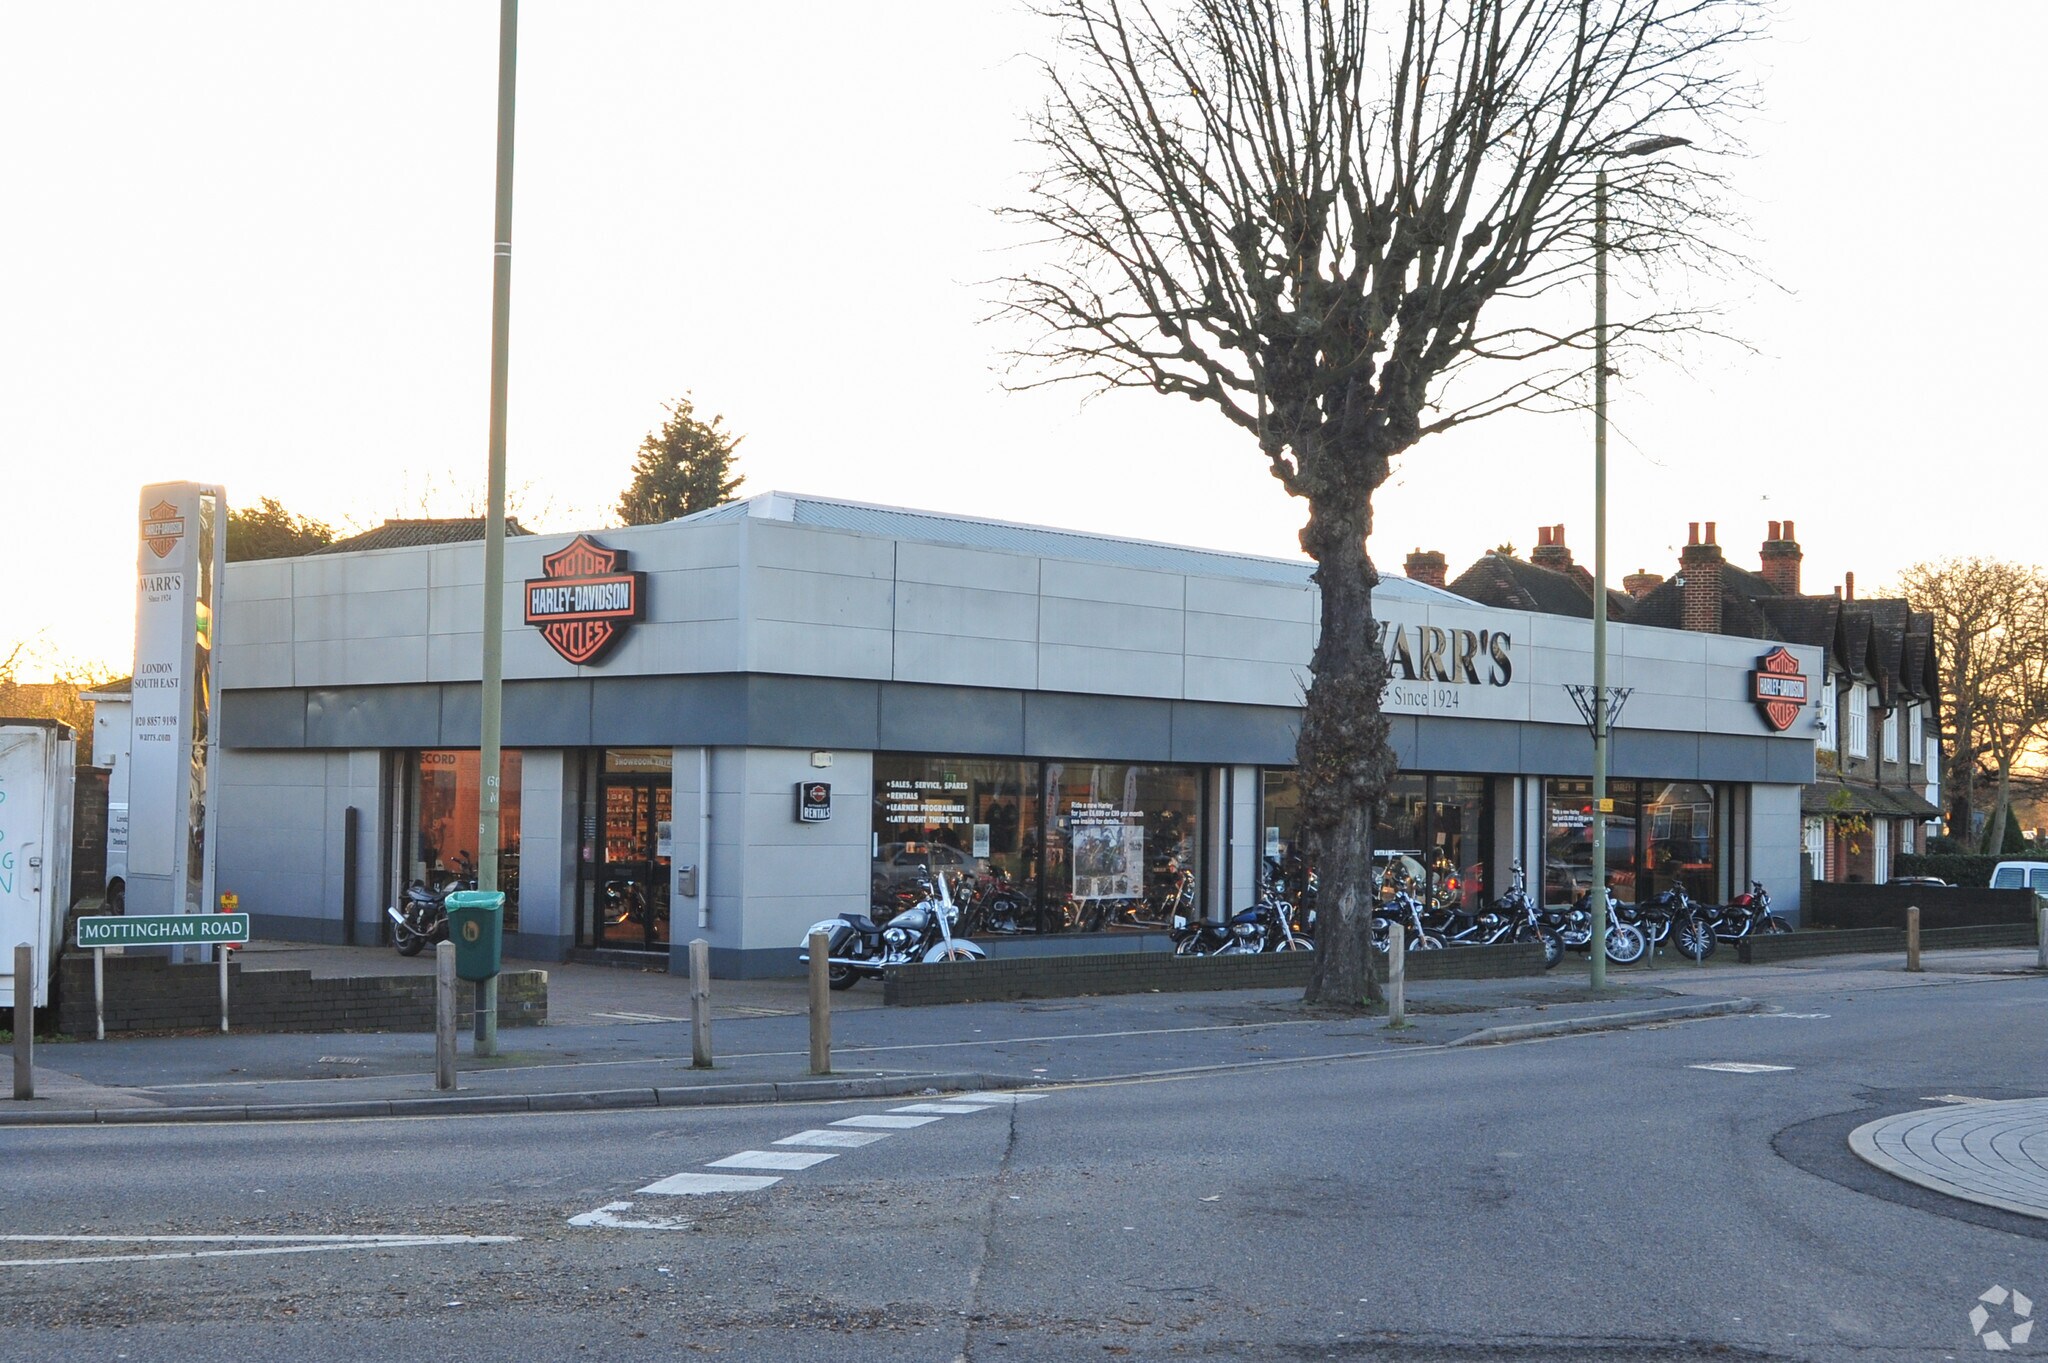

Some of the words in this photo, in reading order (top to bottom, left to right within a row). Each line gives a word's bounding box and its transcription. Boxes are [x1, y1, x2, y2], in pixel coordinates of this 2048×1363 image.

[554, 546, 606, 577] MOTOR
[140, 575, 181, 592] WARR'S
[148, 594, 160, 602] Since
[161, 594, 172, 602] 1924
[532, 582, 629, 614] HARLEY-DAVIDSON
[552, 622, 604, 656] CYCLES
[142, 663, 173, 674] LONDON
[135, 678, 159, 688] SOUTH
[160, 678, 179, 688] EAST
[1394, 686, 1428, 708] Since
[1432, 688, 1459, 708] 1924
[135, 716, 146, 726] 020
[147, 716, 161, 726] 8857
[162, 716, 177, 726] 9198
[139, 734, 171, 742] warrs.com
[891, 780, 912, 789] SALES,
[915, 781, 942, 790] SERVICE,
[944, 782, 968, 790] SPARES
[890, 792, 918, 800] RENTALS
[890, 804, 919, 812] LEARNER
[920, 804, 965, 812] PROGRAMMES
[1098, 802, 1113, 810] Harley
[804, 807, 830, 819] RENTALS
[890, 815, 905, 823] LATE
[929, 816, 950, 824] THURS
[951, 816, 963, 824] TILL
[85, 922, 194, 939] MOTTINGHAM
[201, 921, 243, 936] ROAD
